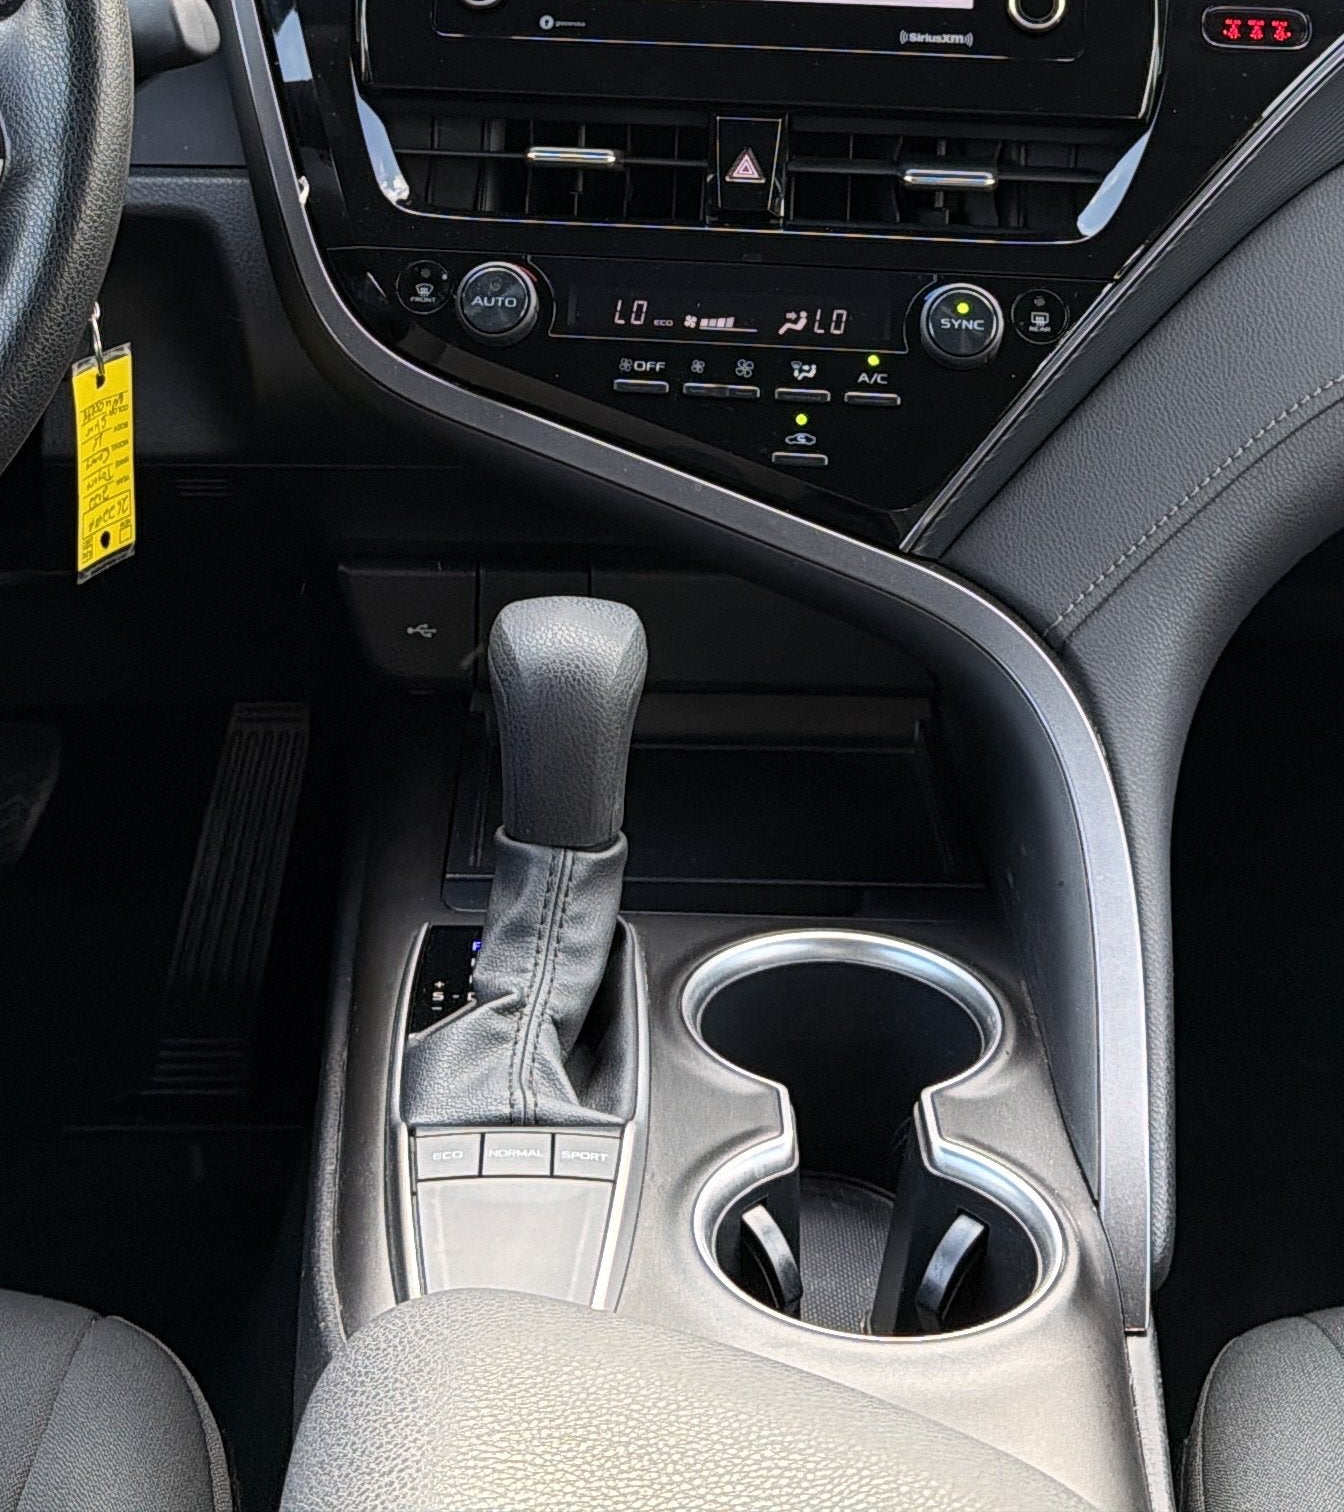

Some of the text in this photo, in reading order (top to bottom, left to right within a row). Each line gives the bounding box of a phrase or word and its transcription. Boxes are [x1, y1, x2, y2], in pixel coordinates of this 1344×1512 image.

[471, 295, 517, 307] AUTO
[940, 318, 985, 331] SYNC
[634, 361, 666, 372] OFF
[858, 372, 888, 385] A/C
[432, 1150, 464, 1160] ECO
[488, 1148, 544, 1158] NORMAL
[561, 1150, 608, 1162] SPORT
